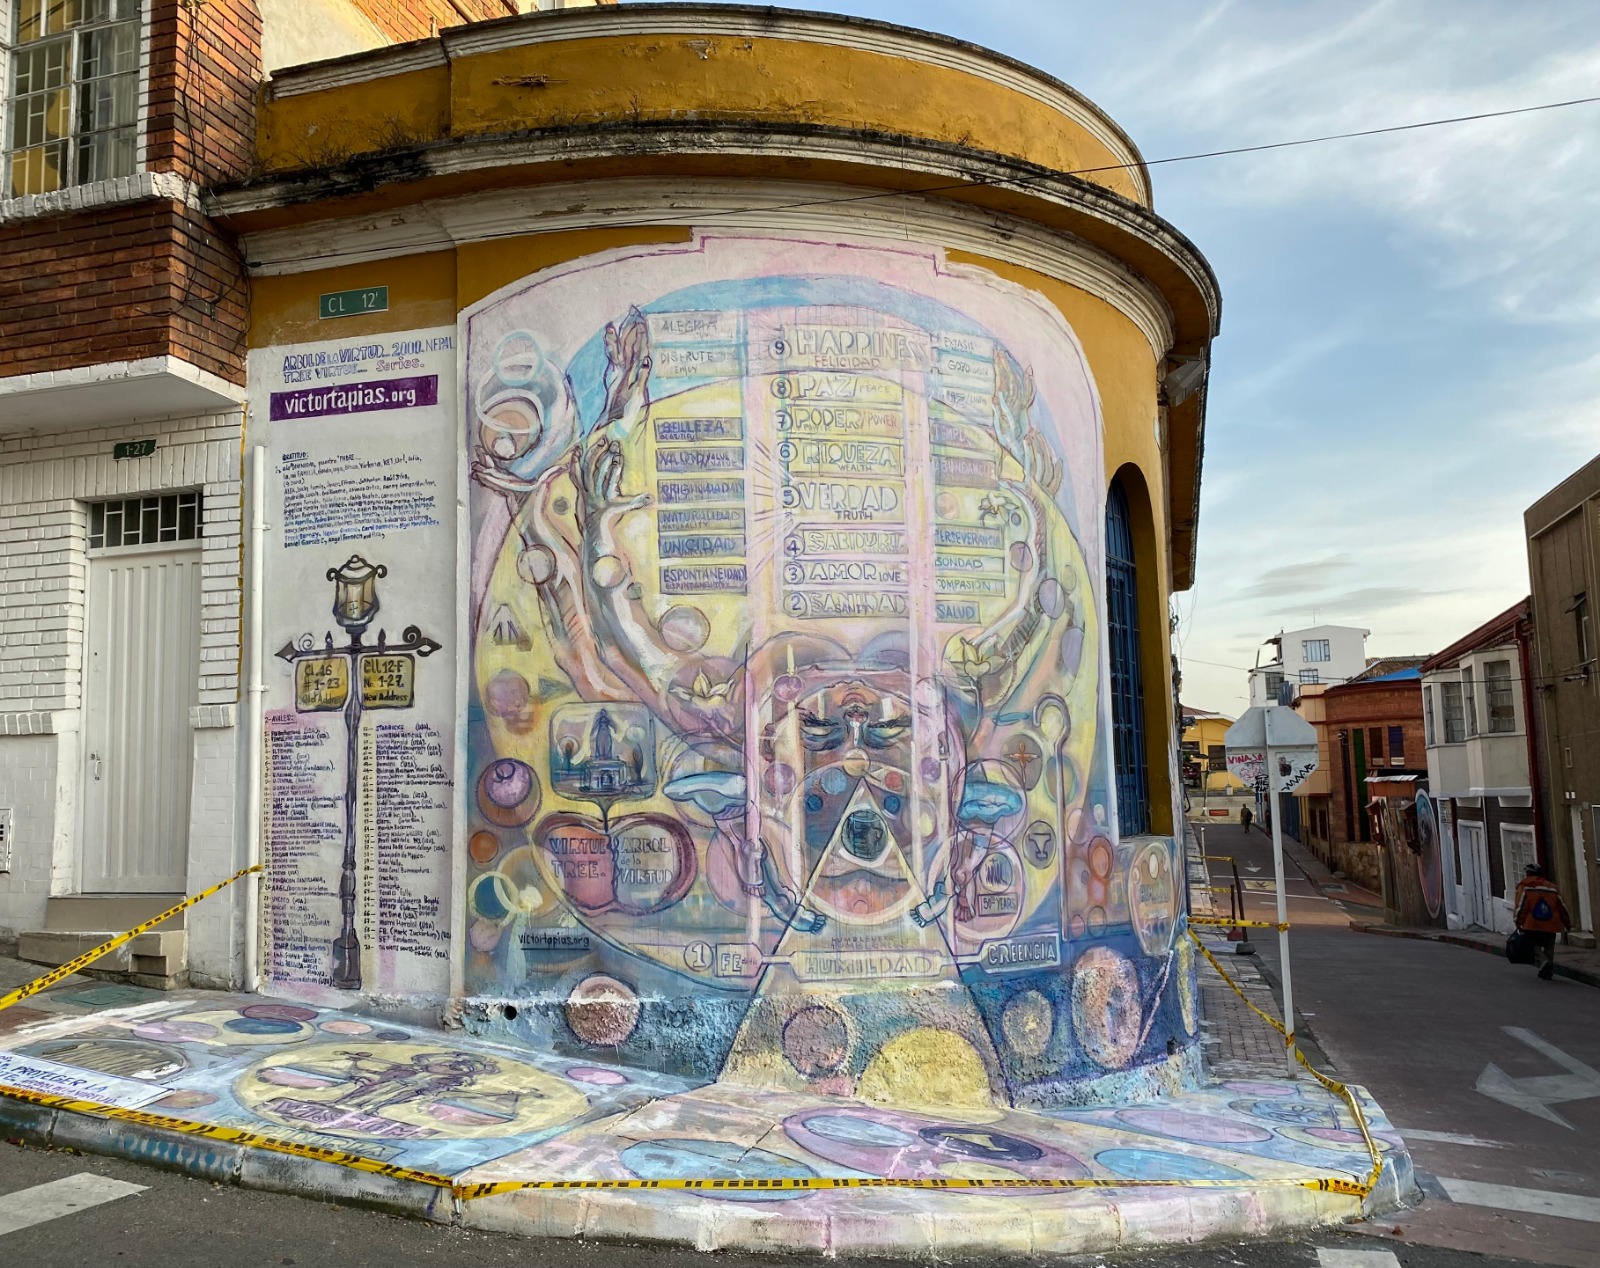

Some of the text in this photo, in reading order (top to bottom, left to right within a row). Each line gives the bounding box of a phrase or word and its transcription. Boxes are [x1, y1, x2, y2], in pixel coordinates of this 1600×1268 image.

[328, 296, 345, 313] CL
[425, 336, 455, 351] NEPAL
[774, 341, 785, 355] 9
[814, 355, 881, 369] FELICIDAD
[284, 368, 312, 383] TREE
[776, 380, 787, 395] 8
[285, 384, 417, 414] victortapias.org
[776, 415, 786, 429] 7
[125, 442, 147, 456] 1-27
[780, 441, 896, 466] 6 RIQUEZA
[783, 481, 898, 512] 5 VERDAD
[834, 510, 873, 520] TRUTH
[786, 540, 800, 555] 4
[935, 556, 983, 569] BONDAD
[788, 563, 901, 582] 3 AMOR LOVE
[791, 592, 907, 615] 2 SANIDAD
[936, 603, 975, 619] SALUD
[378, 690, 408, 702] Address
[548, 837, 670, 855] VIRTUE ARBOL
[620, 855, 641, 866] de la
[620, 868, 673, 884] VIRTUD
[518, 931, 590, 948] victortapias.org
[691, 944, 707, 967] 1
[720, 953, 742, 972] FE
[987, 942, 1056, 966] CREENCIA
[805, 956, 932, 975] HUMILDAD
